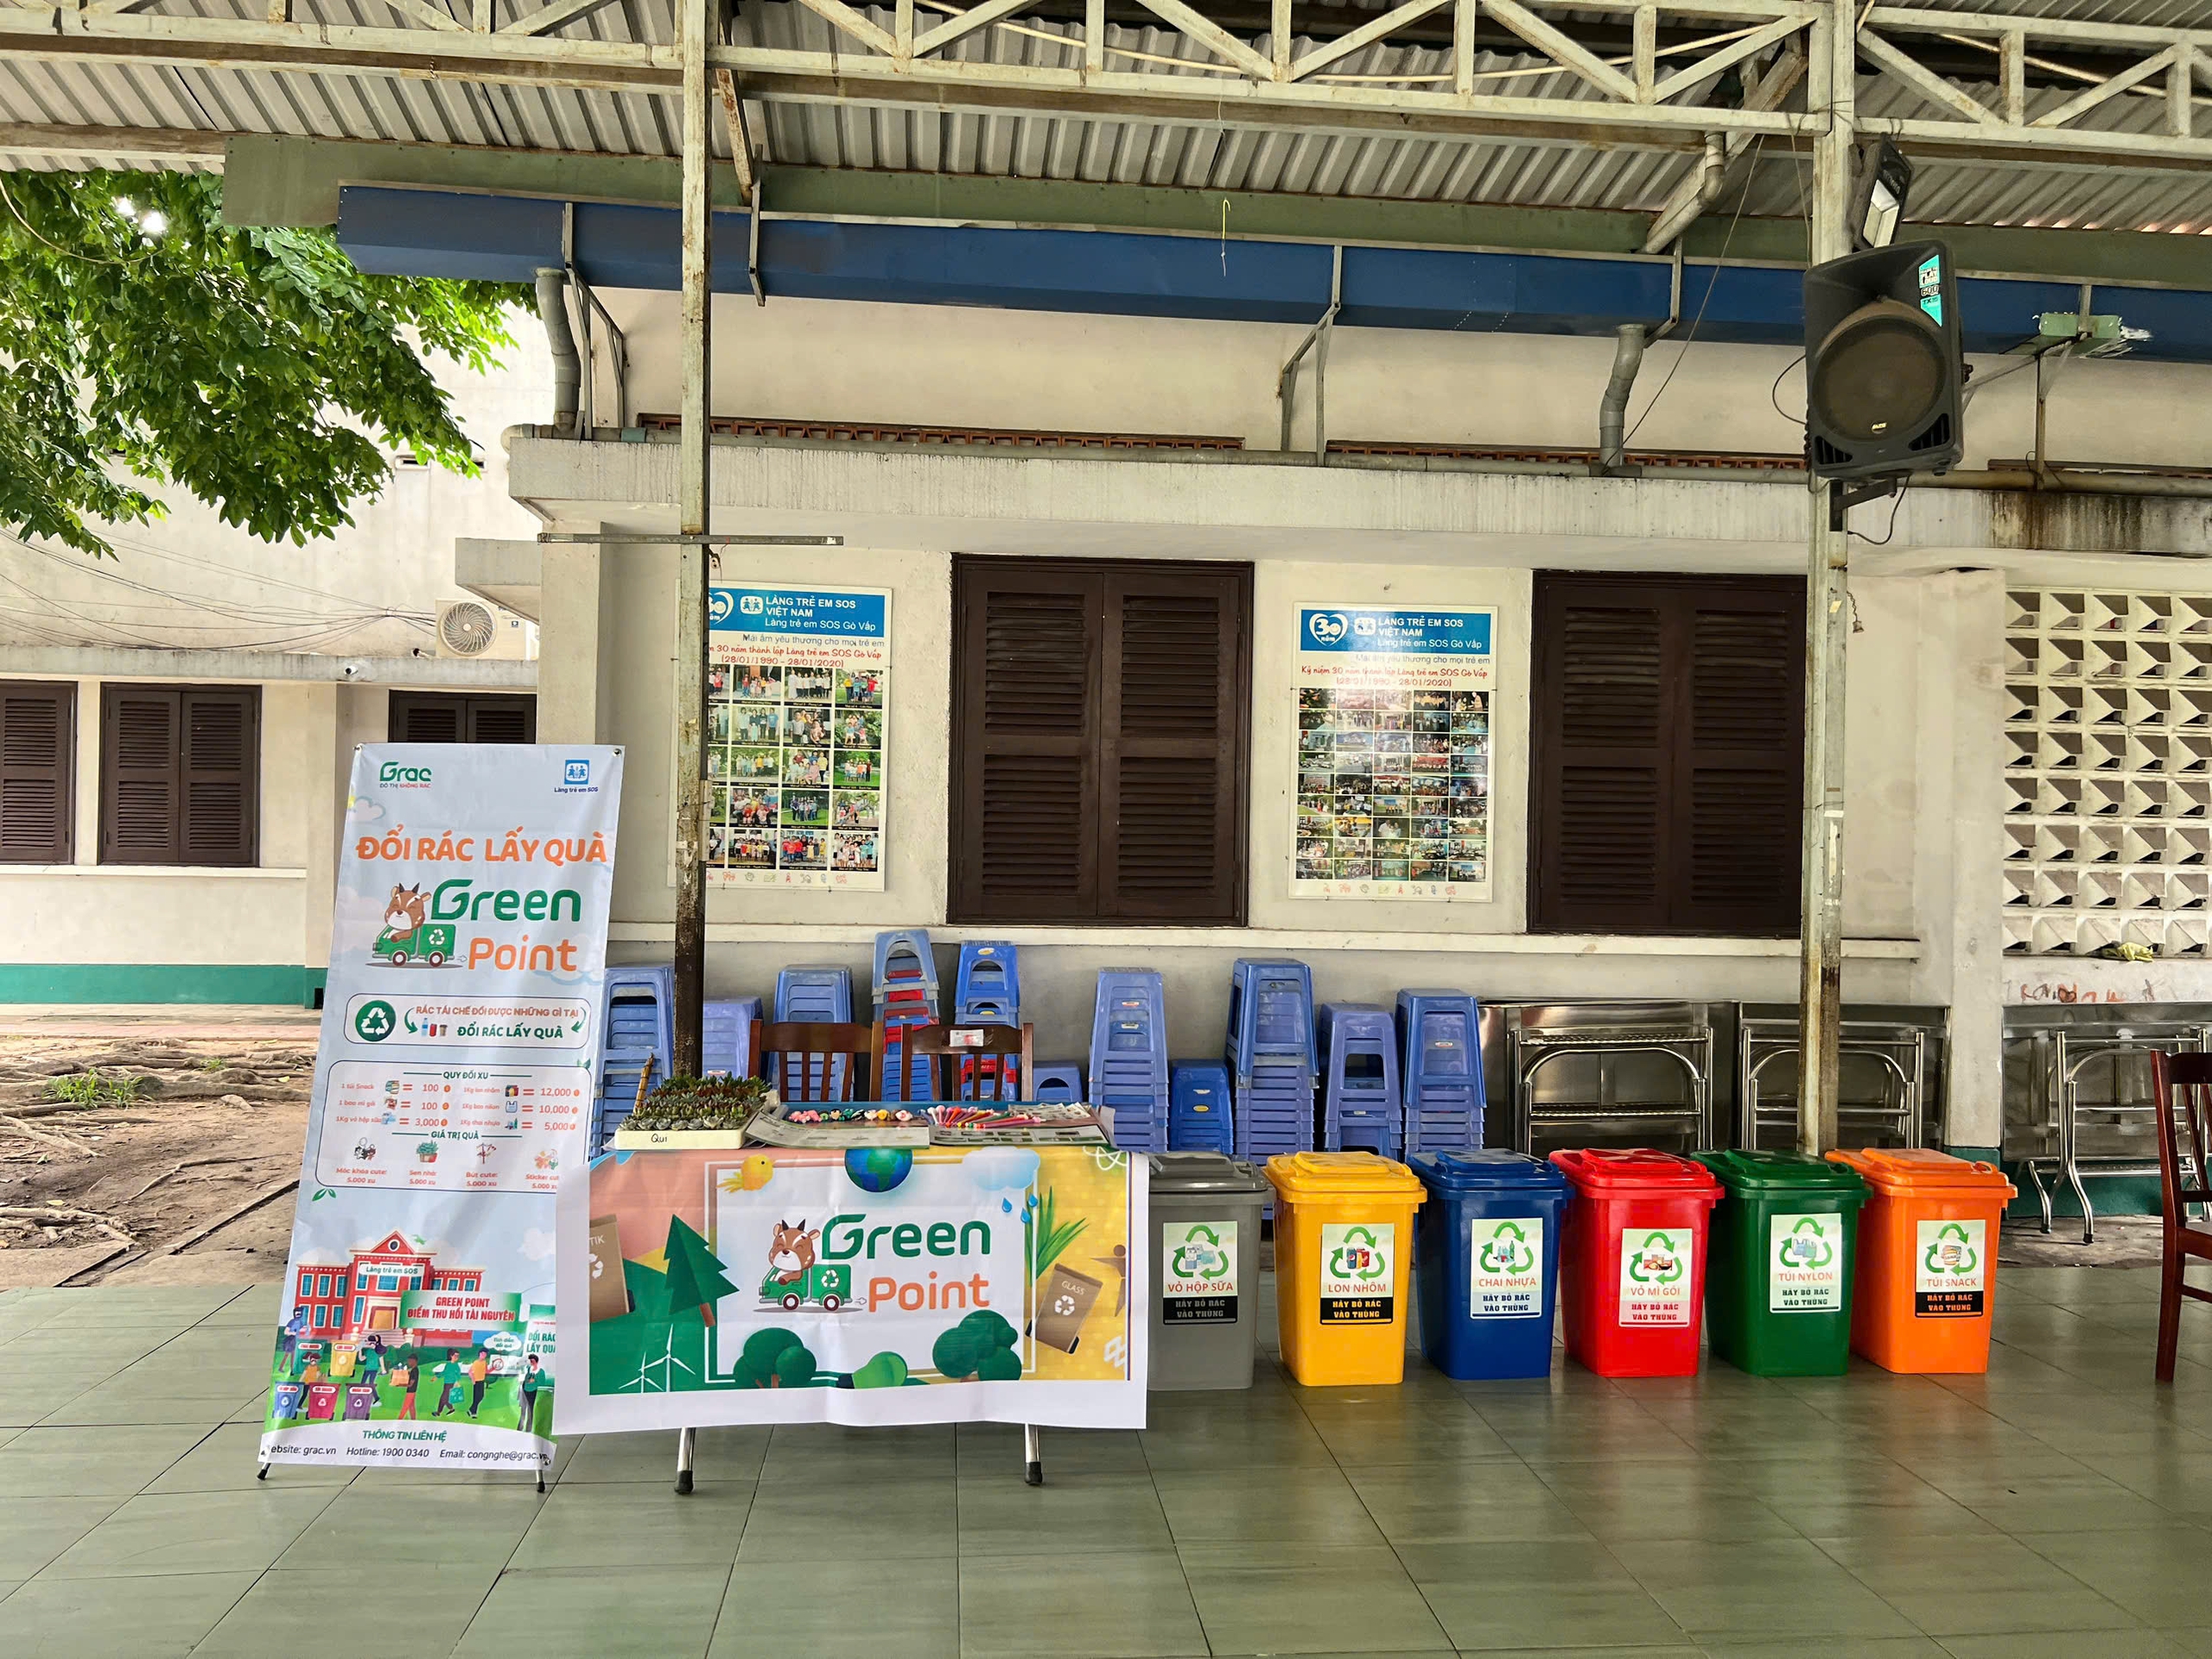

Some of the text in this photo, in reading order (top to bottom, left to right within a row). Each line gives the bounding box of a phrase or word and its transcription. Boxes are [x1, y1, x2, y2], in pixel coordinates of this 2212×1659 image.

[766, 594, 856, 609] LÀNG TRẺ EM SOS
[766, 607, 813, 617] VIỆT NAM
[765, 619, 787, 629] Làng
[789, 620, 802, 628] trẻ
[820, 620, 840, 629] SOS
[843, 621, 856, 630] Gò
[858, 620, 876, 632] Vấp
[1378, 616, 1404, 626] LÀNG
[1407, 615, 1426, 626] TRẺ
[1378, 627, 1399, 637] VIỆT
[742, 633, 758, 642] Mái
[775, 635, 790, 645] yêu
[792, 636, 822, 646] thương
[824, 637, 839, 645] cho
[859, 638, 869, 646] trẻ
[1377, 639, 1398, 648] Làng
[1465, 638, 1482, 650] Vấp
[731, 645, 747, 653] năm
[749, 645, 771, 653] thành
[772, 645, 784, 656] lập
[786, 648, 804, 657] Làng
[807, 647, 817, 656] trẻ
[831, 649, 852, 658] SOS
[854, 650, 865, 658] Gò
[867, 649, 881, 659] Vấp
[721, 656, 844, 668] (28/01/1990 28/01/2020)
[379, 761, 432, 782] Grac
[355, 824, 607, 867] ĐỔI RÁC LẤY QUÀ
[430, 879, 582, 922] Green
[467, 935, 577, 971] Point
[416, 1005, 579, 1018] RÁC TÁI CHẾ ĐỔI ĐƯỢC NHỮNG GÌ TẠI
[457, 1021, 563, 1039] ĐỔI RÁC LẤY QUÀ
[443, 1071, 461, 1079] QUY
[462, 1071, 476, 1079] ĐỔI
[422, 1102, 437, 1110] 100
[431, 1129, 445, 1138] GIÁ
[448, 1131, 461, 1141] TRỊ
[821, 1214, 991, 1261] Green
[366, 1265, 381, 1274] Làng
[1779, 1271, 1833, 1281] TÚI NYLON
[1062, 1281, 1085, 1295] GLASS
[1168, 1281, 1233, 1294] VỎ HỘP SỮA
[1328, 1281, 1386, 1293] LON NHÔM
[1478, 1277, 1536, 1287] CHAI NHỰA
[1926, 1276, 1976, 1287] TÚI SNACK
[868, 1273, 988, 1312] Point
[1630, 1285, 1680, 1295] VỎ MÌ GÓI
[435, 1297, 490, 1308] GREEN POINT
[432, 1309, 447, 1319] THU
[449, 1307, 463, 1319] HỒI
[465, 1309, 479, 1319] TÀI
[481, 1310, 515, 1321] NGUYÊN
[363, 1428, 447, 1443] THÔNG TIN LIÊN HỆ
[270, 1445, 301, 1454] ebsite:
[303, 1446, 336, 1456] grac.vn
[346, 1447, 380, 1456] Hotline:
[382, 1447, 404, 1457] 1900
[405, 1448, 429, 1458] 0340
[440, 1449, 465, 1459] Email:
